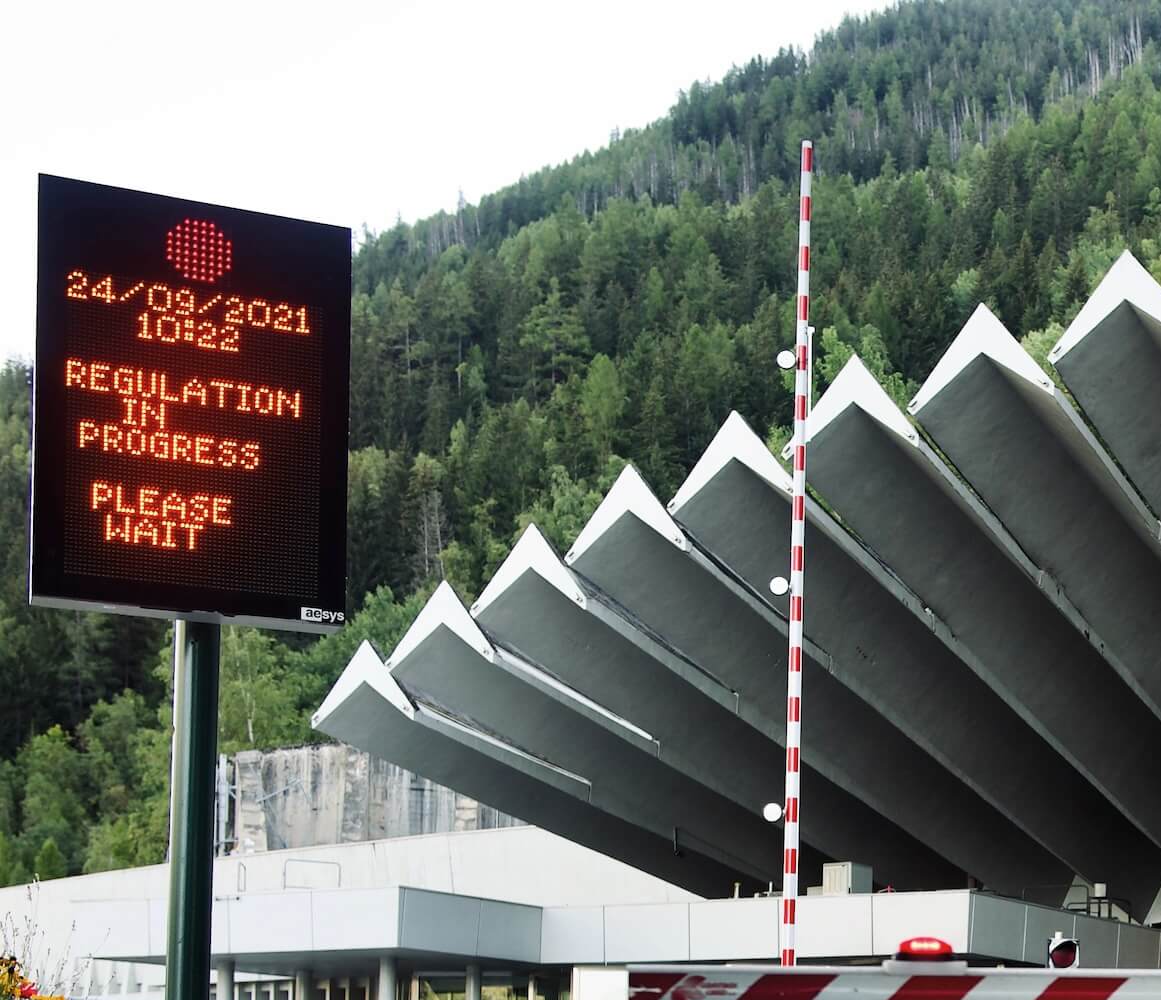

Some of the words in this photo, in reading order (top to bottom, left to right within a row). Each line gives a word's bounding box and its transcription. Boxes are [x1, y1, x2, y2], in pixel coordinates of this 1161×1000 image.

[67, 271, 310, 333] 24/09/2021
[138, 312, 239, 351] 10:22
[66, 359, 300, 418] REGULATION
[121, 399, 166, 430] IN
[79, 421, 260, 470] PROGRESS
[91, 481, 232, 525] PLEASE
[105, 512, 205, 550] WAIT
[305, 609, 345, 623] aesys
